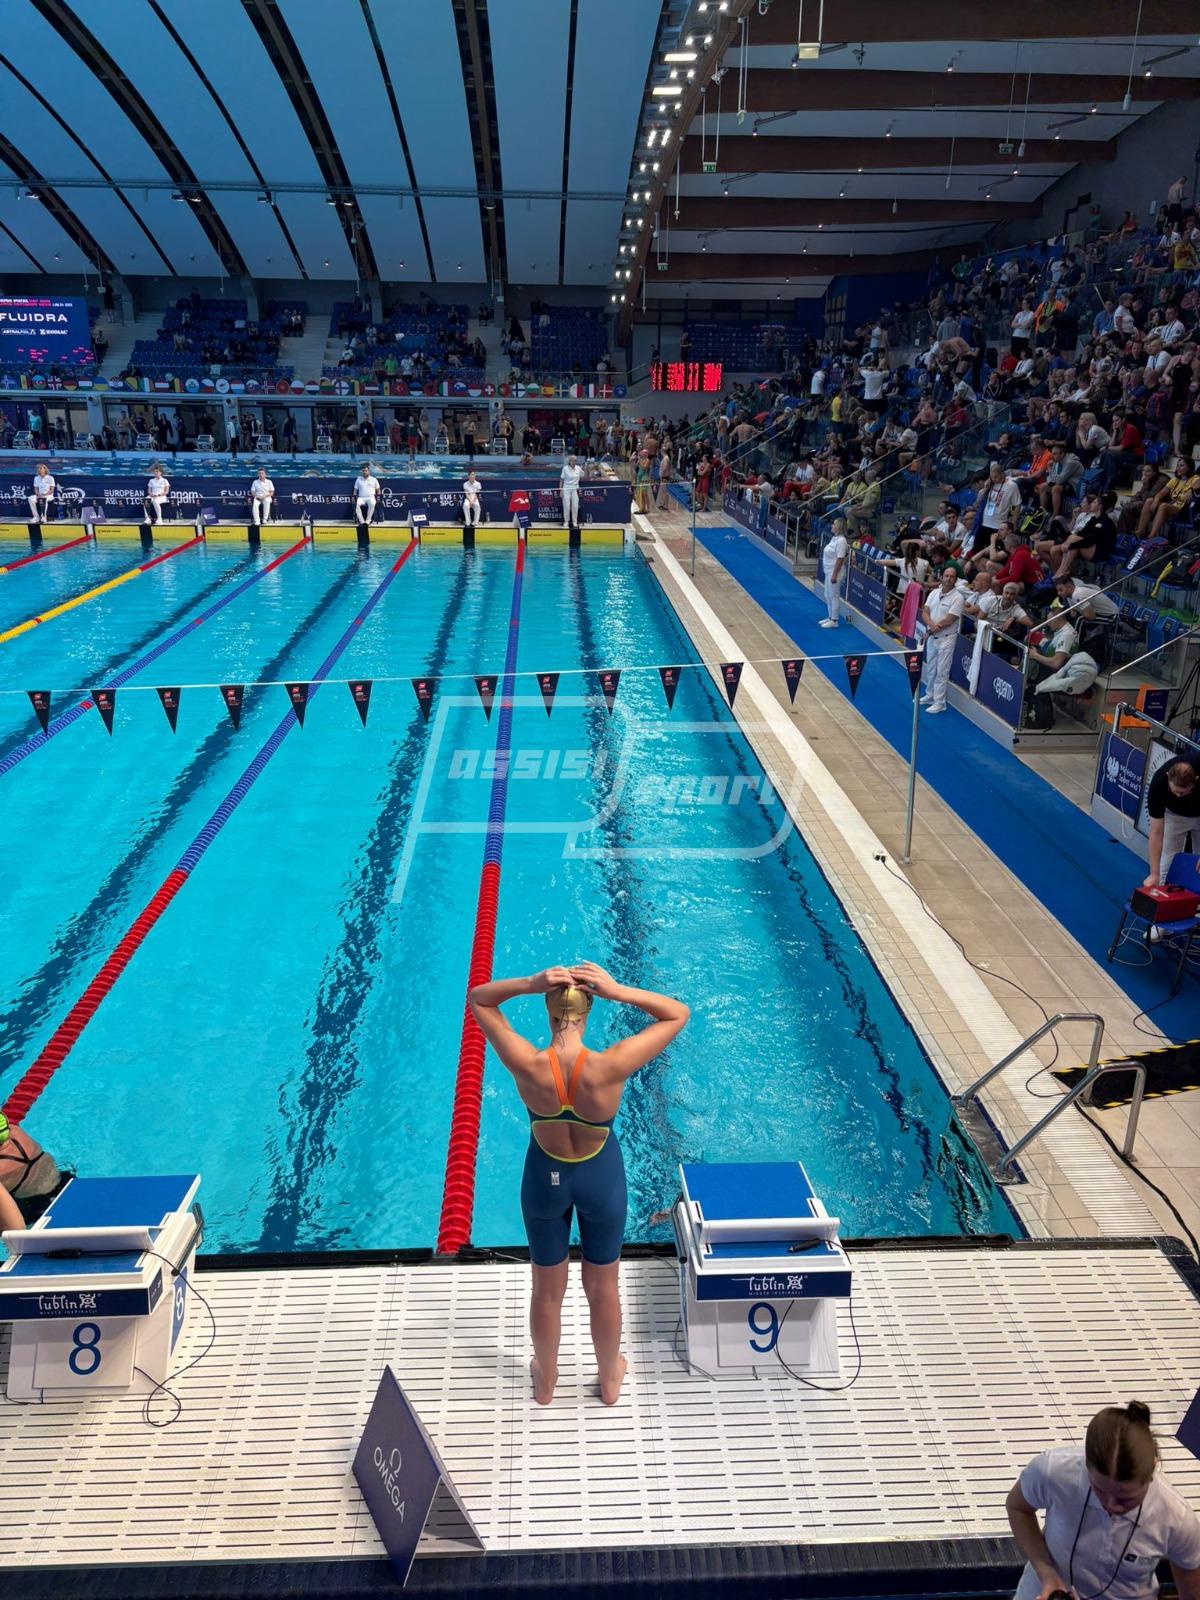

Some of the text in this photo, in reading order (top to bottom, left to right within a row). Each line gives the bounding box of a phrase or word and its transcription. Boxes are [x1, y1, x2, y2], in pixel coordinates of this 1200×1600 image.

[0, 313, 68, 323] FLUIDRA
[104, 489, 145, 498] EUROPEAN
[1127, 547, 1145, 570] arena
[176, 1287, 184, 1321] 8
[748, 1302, 778, 1353] 9
[69, 1322, 102, 1375] 8
[373, 1446, 405, 1524] OMEGA
